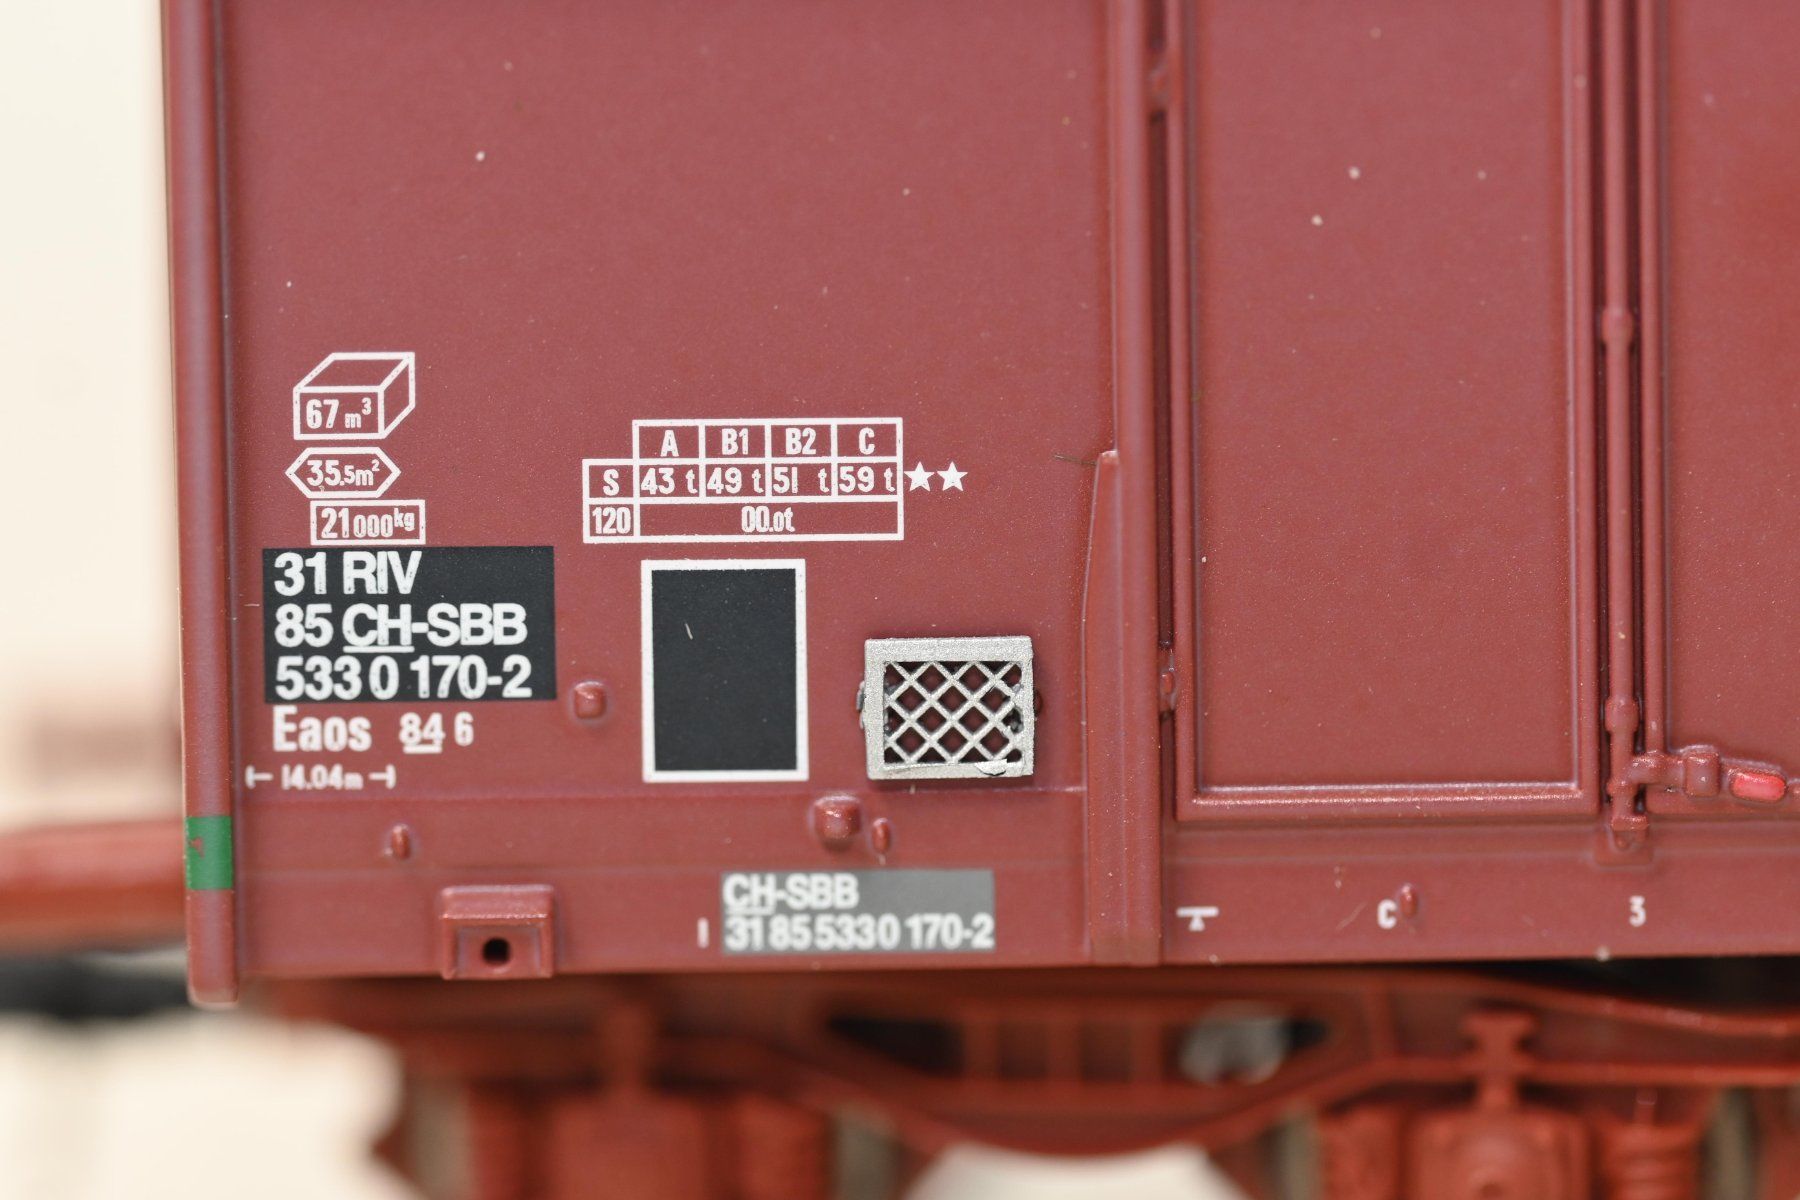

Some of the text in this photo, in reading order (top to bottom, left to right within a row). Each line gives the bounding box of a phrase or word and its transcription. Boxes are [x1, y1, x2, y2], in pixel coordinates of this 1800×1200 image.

[306, 399, 339, 429] 67
[660, 427, 875, 457] A B1 B2 C
[602, 469, 620, 496] S
[641, 468, 676, 495] 43
[707, 467, 743, 495] 49
[838, 465, 875, 493] 59
[592, 506, 632, 534] 120
[274, 550, 423, 596] 31 RIV
[274, 603, 528, 653] 85 CH-SBB
[409, 654, 533, 699] 170-2
[272, 704, 475, 754] Eaos 84 6
[723, 873, 860, 915] CH-SBB
[1629, 895, 1647, 927] 3
[1377, 899, 1398, 929] C
[725, 915, 764, 951] 31
[767, 915, 812, 951] 85
[904, 913, 995, 950] 170-2
